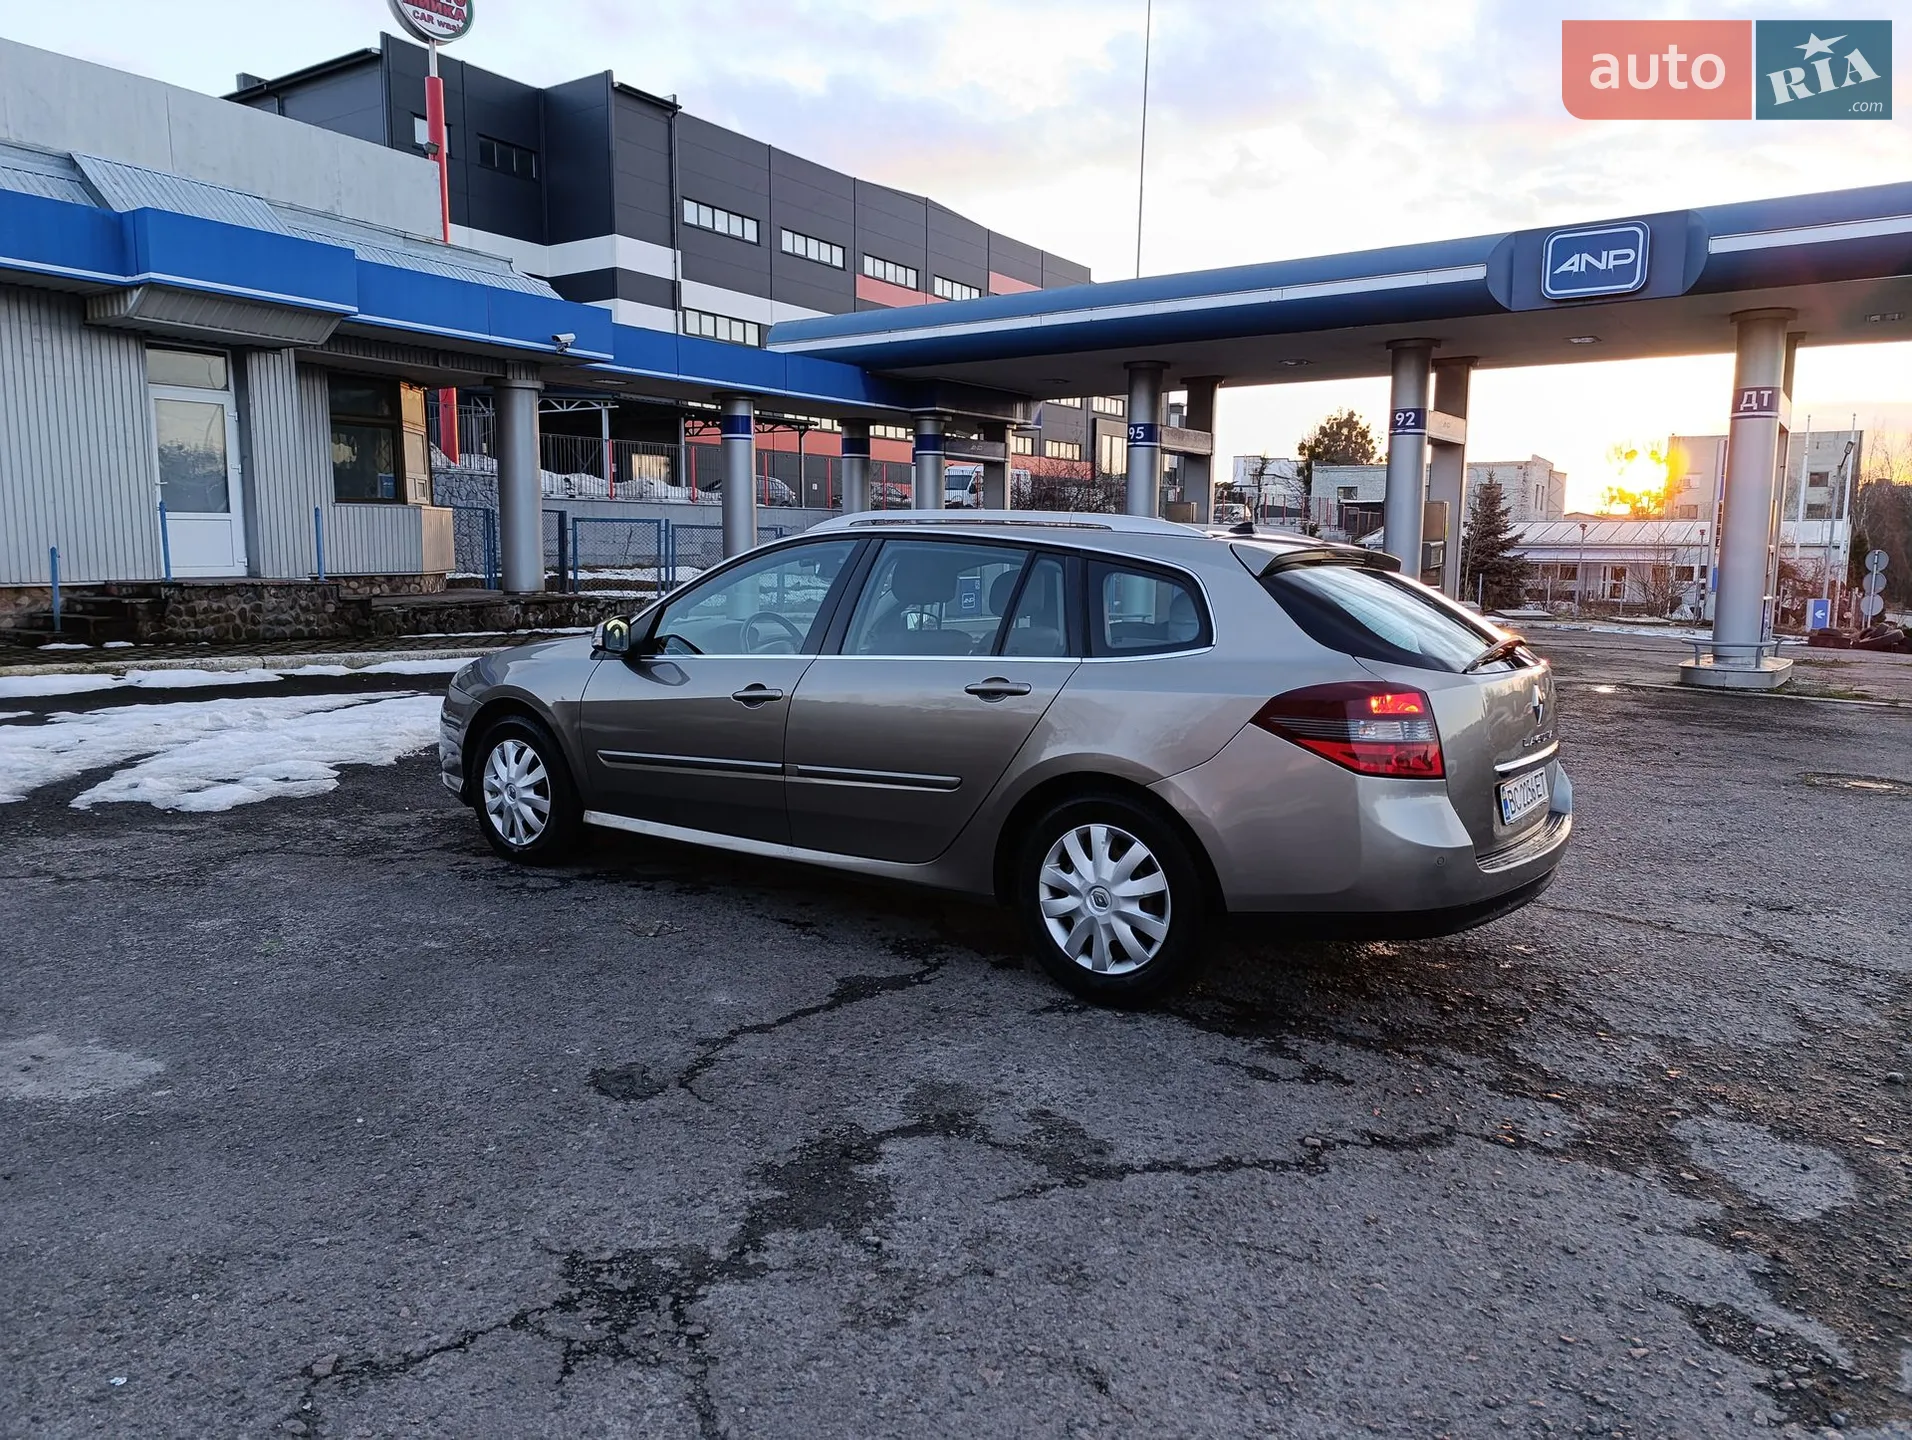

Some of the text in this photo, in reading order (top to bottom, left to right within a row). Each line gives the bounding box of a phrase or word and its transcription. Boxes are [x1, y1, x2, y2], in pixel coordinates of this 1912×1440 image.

[413, 10, 435, 25] CAR
[1552, 248, 1636, 274] ANP
[1740, 390, 1772, 411] ДТ
[1395, 411, 1416, 426] 92
[1128, 426, 1145, 440] 95
